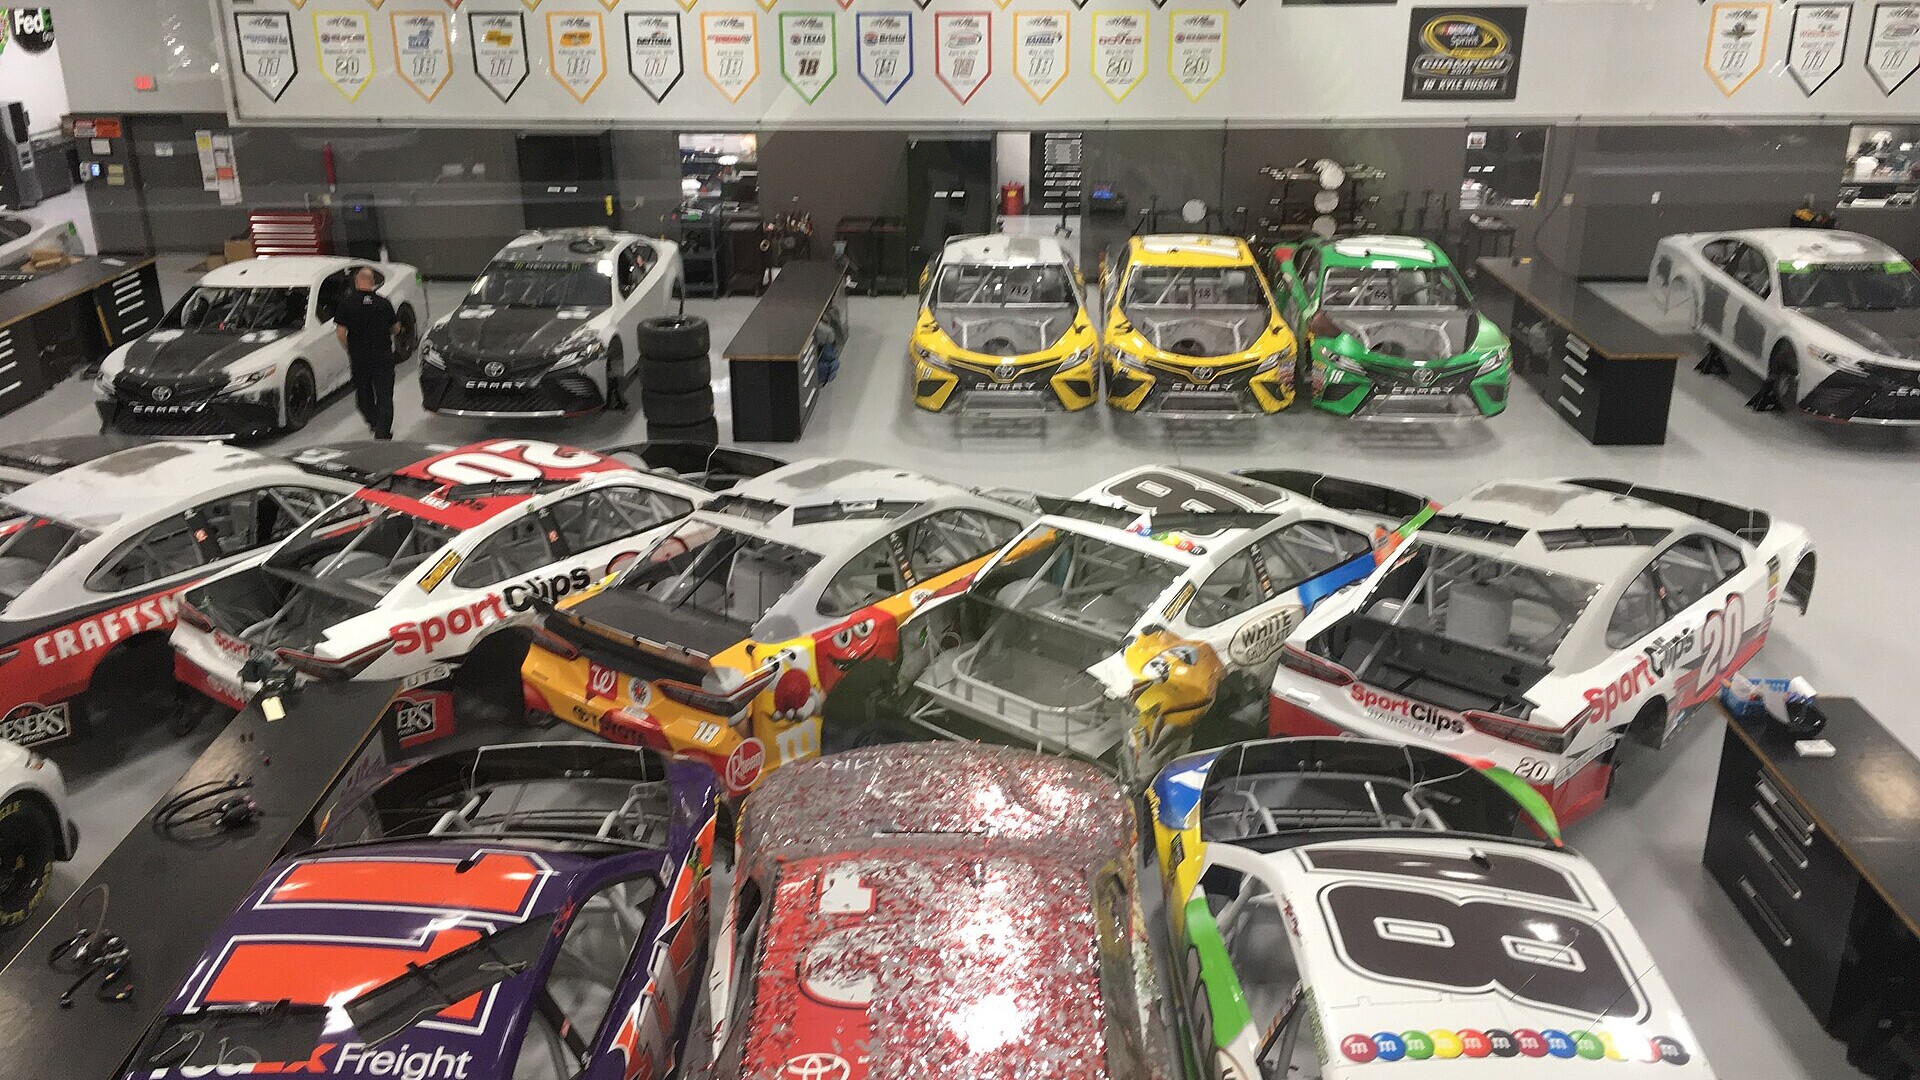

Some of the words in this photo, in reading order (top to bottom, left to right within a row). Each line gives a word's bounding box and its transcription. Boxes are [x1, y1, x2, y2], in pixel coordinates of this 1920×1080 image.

[879, 34, 907, 43] Bristol
[335, 57, 360, 76] 20
[798, 58, 820, 77] 18
[1421, 59, 1506, 70] CHAMPION
[1438, 79, 1464, 91] KYLE
[1463, 79, 1500, 91] BUSCH
[33, 594, 179, 666] CRAFTSM
[1696, 592, 1746, 694] 20
[1513, 756, 1551, 782] 20
[333, 1042, 474, 1080] Freight
